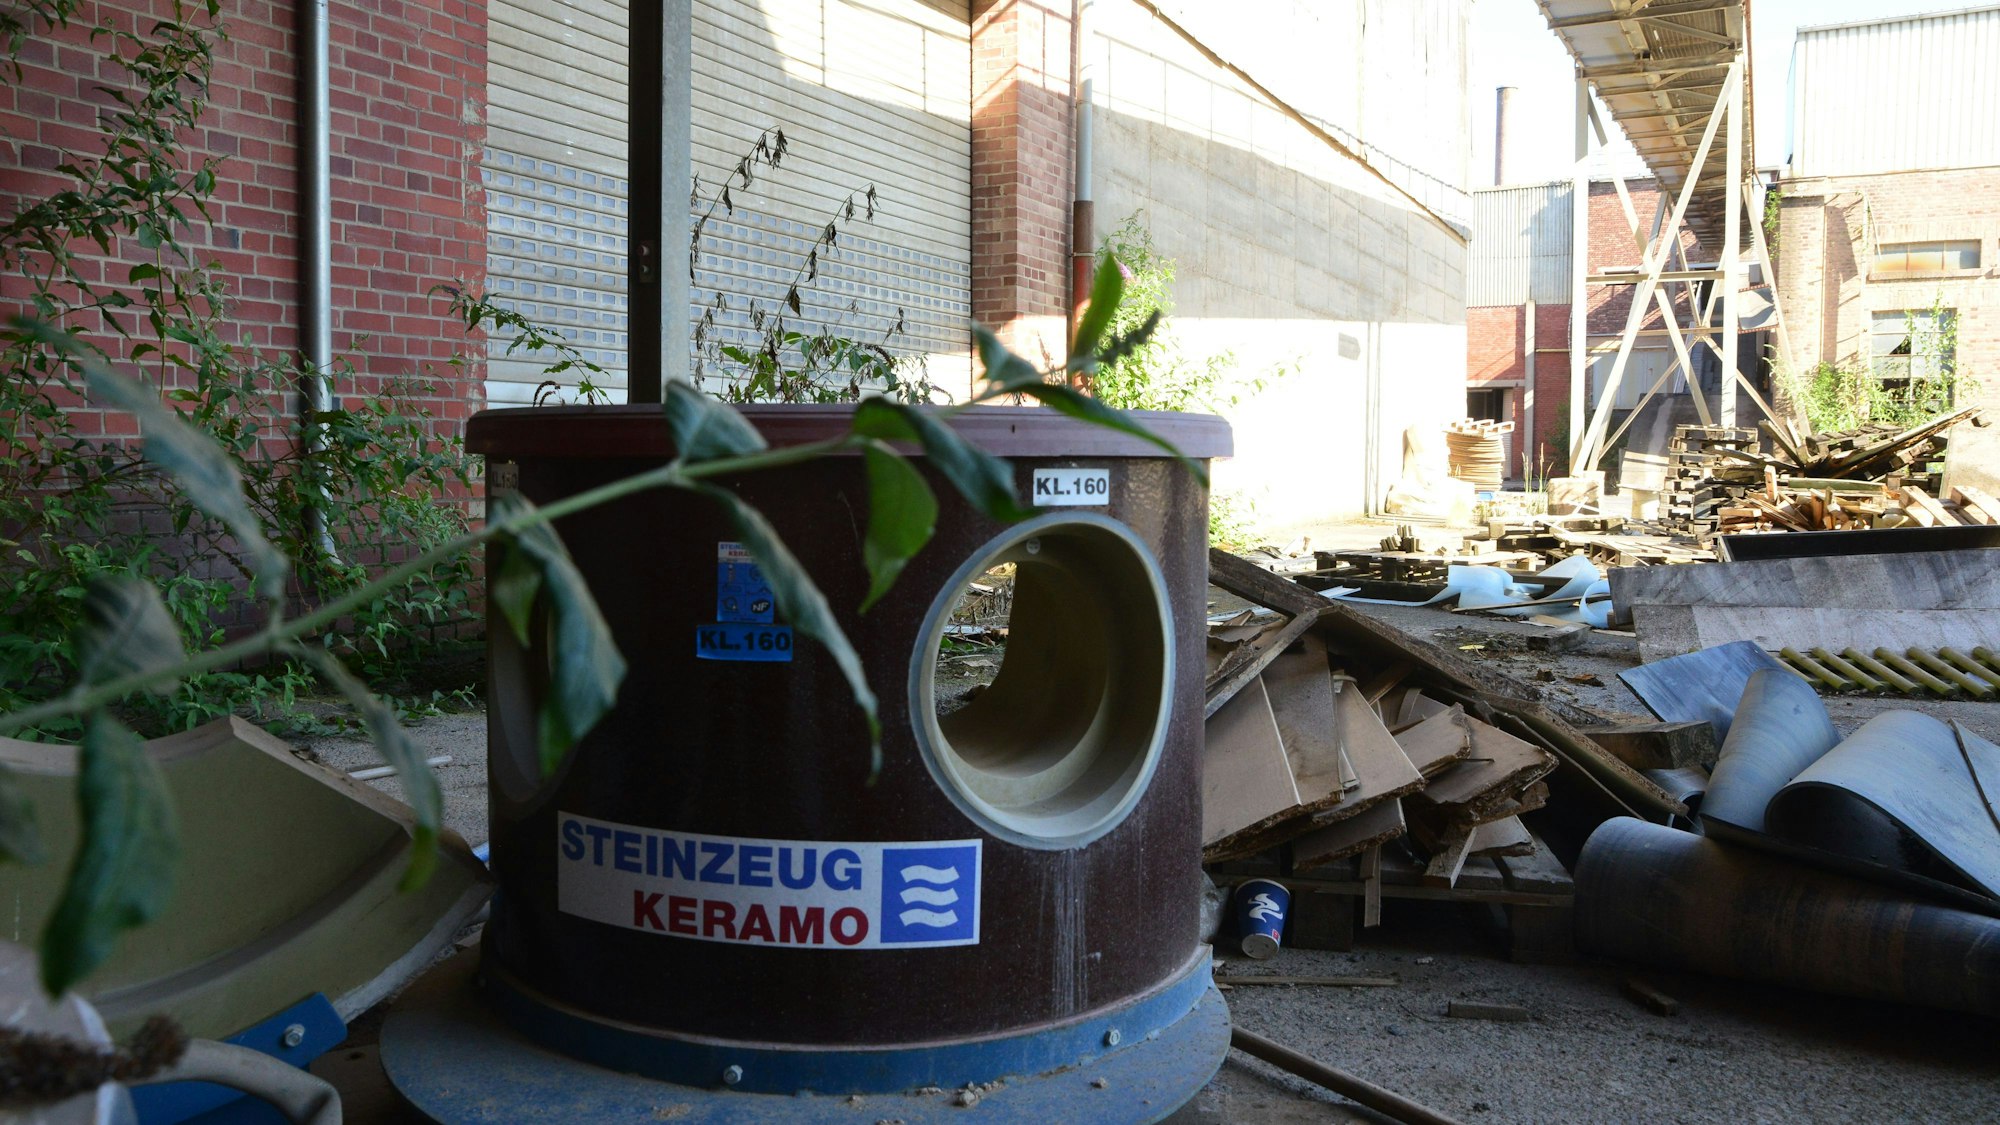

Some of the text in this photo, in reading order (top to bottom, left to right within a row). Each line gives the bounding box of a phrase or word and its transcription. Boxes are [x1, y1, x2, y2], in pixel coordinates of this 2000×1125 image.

[1036, 477, 1107, 495] KL.160
[752, 601, 769, 612] NF
[700, 630, 791, 651] KL.160
[561, 819, 863, 891] STEINZEUG
[633, 890, 870, 946] KERAMO
